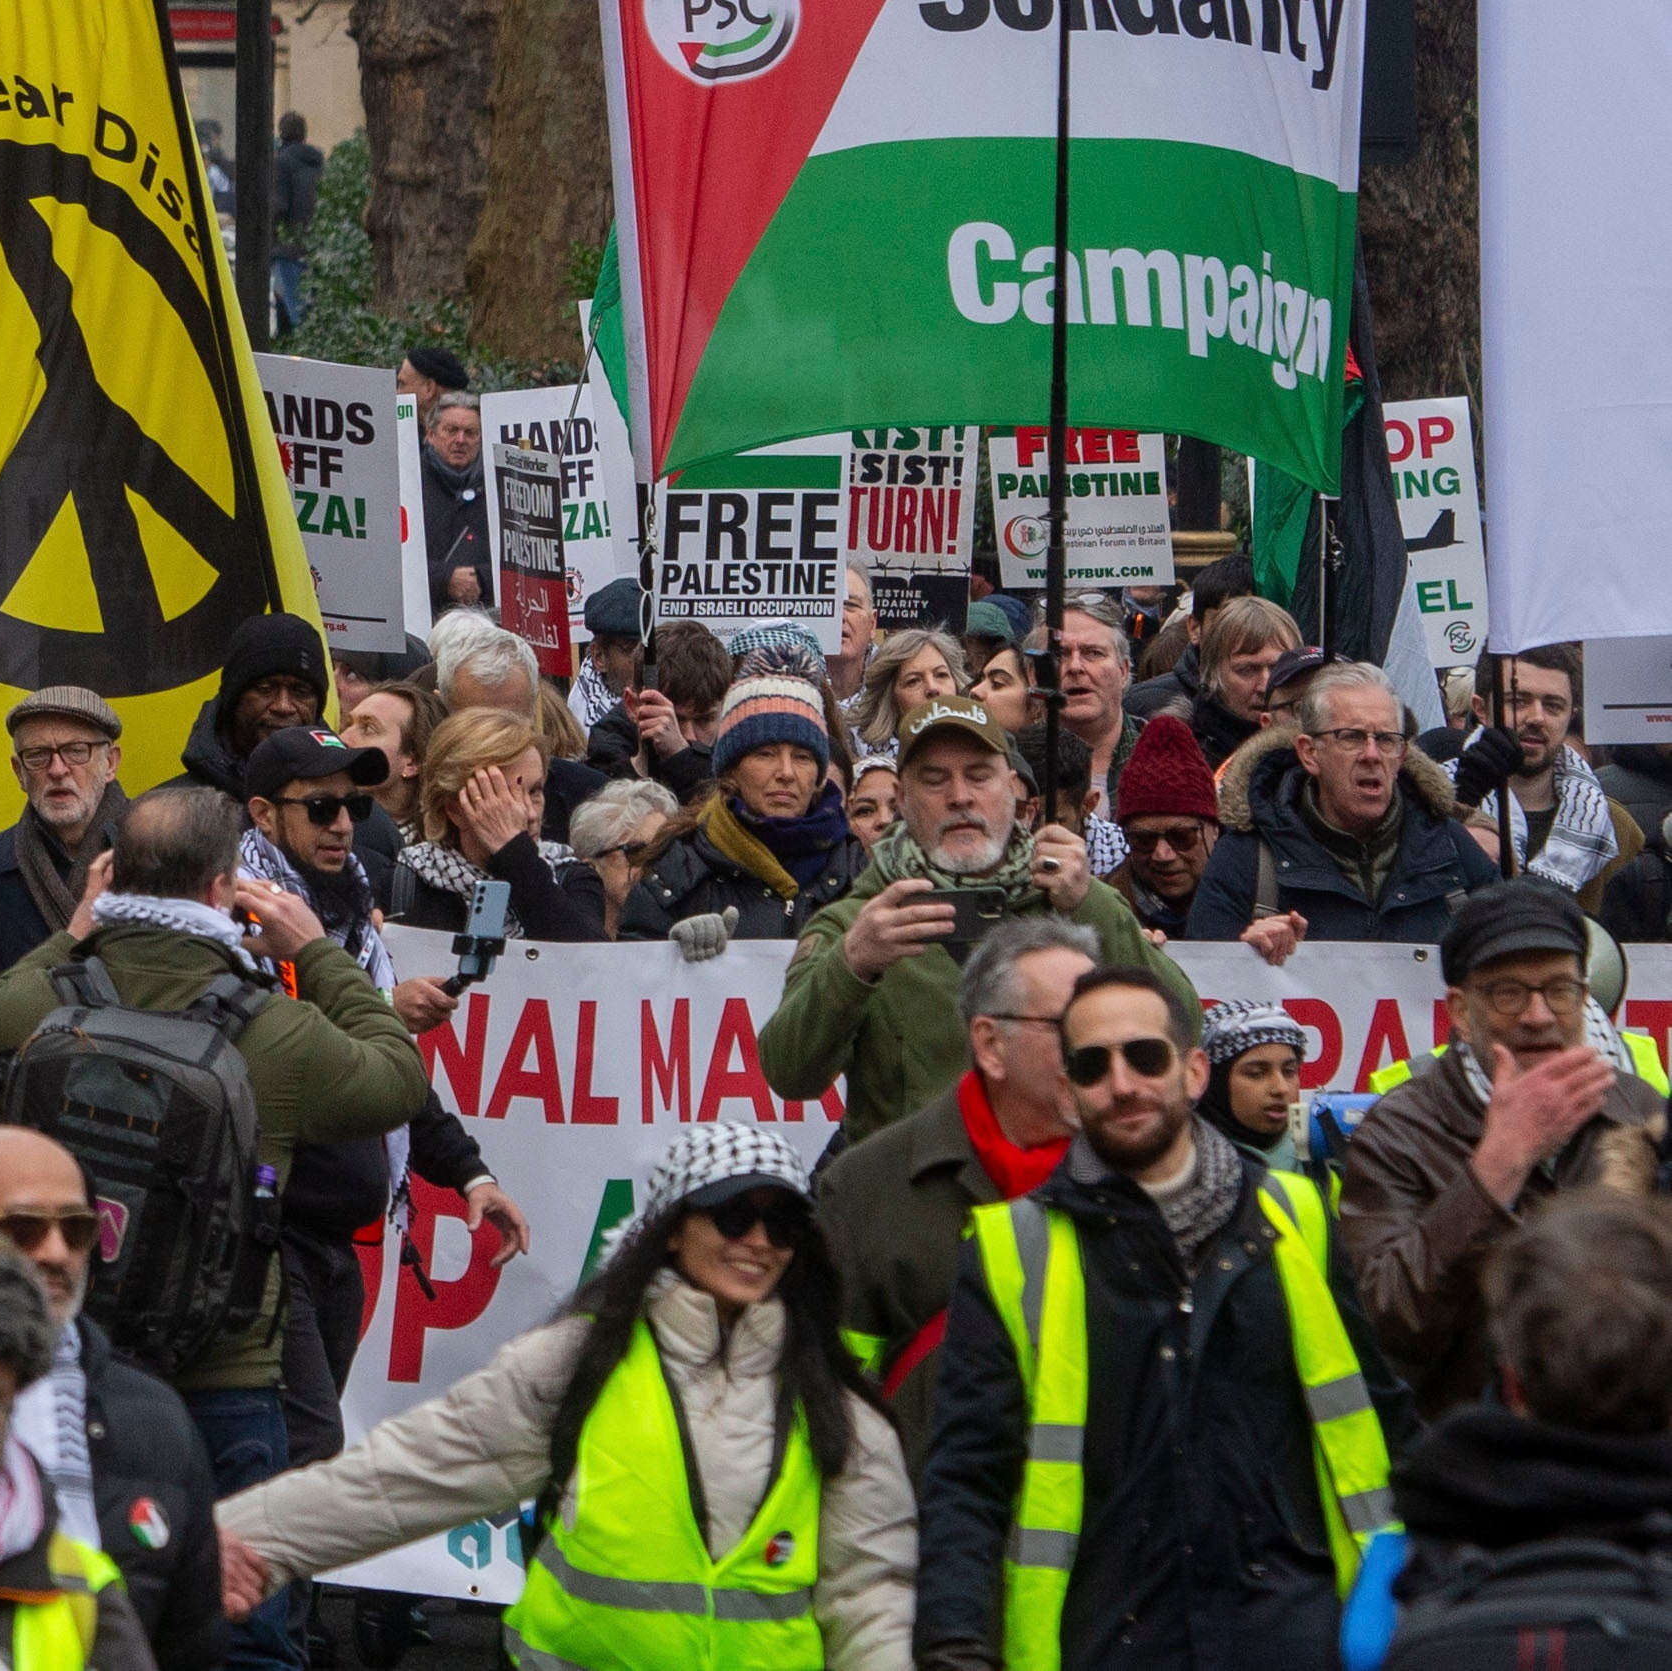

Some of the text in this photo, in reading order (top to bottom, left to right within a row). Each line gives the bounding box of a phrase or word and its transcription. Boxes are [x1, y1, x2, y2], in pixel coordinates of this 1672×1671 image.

[946, 220, 1334, 391] Campaign
[1384, 415, 1456, 463] OP
[850, 452, 965, 487] SIST!
[503, 475, 554, 520] FREEDOM
[293, 490, 368, 541] ZA!
[561, 499, 612, 543] ZA!
[662, 492, 841, 562] FREE
[847, 485, 962, 556] TURN!
[502, 527, 562, 575] PALESTINE
[1064, 538, 1098, 549] estinian
[1099, 537, 1127, 548] Forum
[1138, 535, 1166, 546] Britain
[659, 563, 837, 597] PALESTINE
[872, 588, 923, 599] ESTINE
[660, 600, 835, 618] END ISRAELI OCCUPATION
[872, 599, 930, 610] IDARITY
[878, 608, 919, 619] PAIGN
[1448, 629, 1472, 644] PSC
[909, 701, 988, 735] فلسطين
